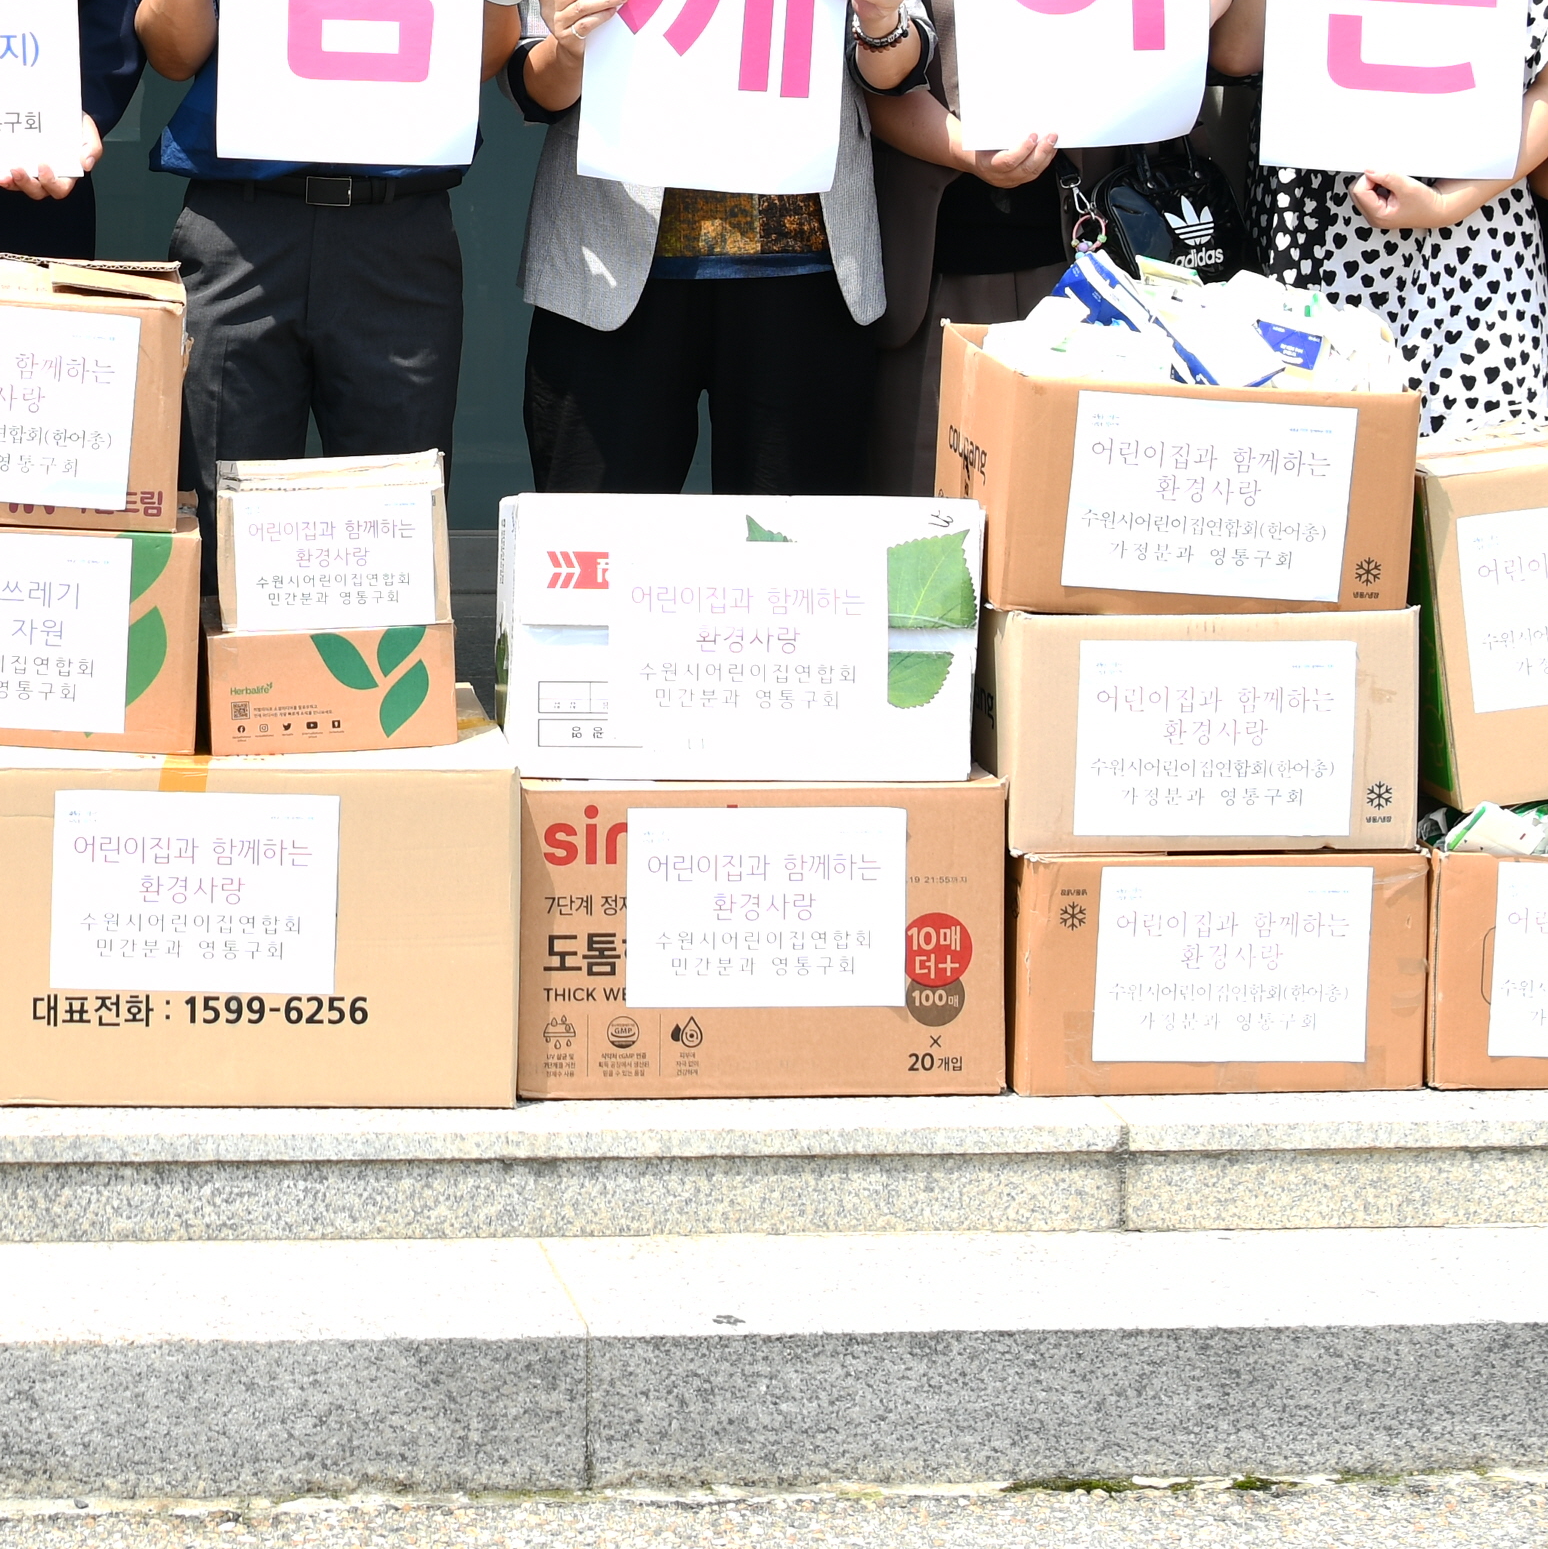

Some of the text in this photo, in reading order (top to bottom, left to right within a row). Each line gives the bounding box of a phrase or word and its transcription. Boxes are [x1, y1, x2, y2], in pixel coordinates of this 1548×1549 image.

[1174, 247, 1224, 268] adidas
[12, 618, 64, 647] 자원
[230, 682, 272, 696] Herbalife
[73, 835, 313, 868] 어린이집과 함께하는
[647, 853, 882, 883] 어린이집과 함께하는
[139, 875, 246, 905] 환경사랑
[544, 896, 593, 917] 7단계
[712, 892, 816, 921] 환경사랑
[79, 912, 301, 936] 수원시어린이집연합회
[96, 937, 284, 961] 민간분과 영통구회
[655, 929, 872, 950] 수원시어린이집연합회
[906, 925, 962, 952] 10매
[671, 955, 855, 976] 민간분과 영통구회
[543, 987, 597, 1002] THICK
[910, 989, 960, 1008] 100매
[32, 994, 369, 1028] 대표전화 1599-6256
[614, 1026, 632, 1035] GMP
